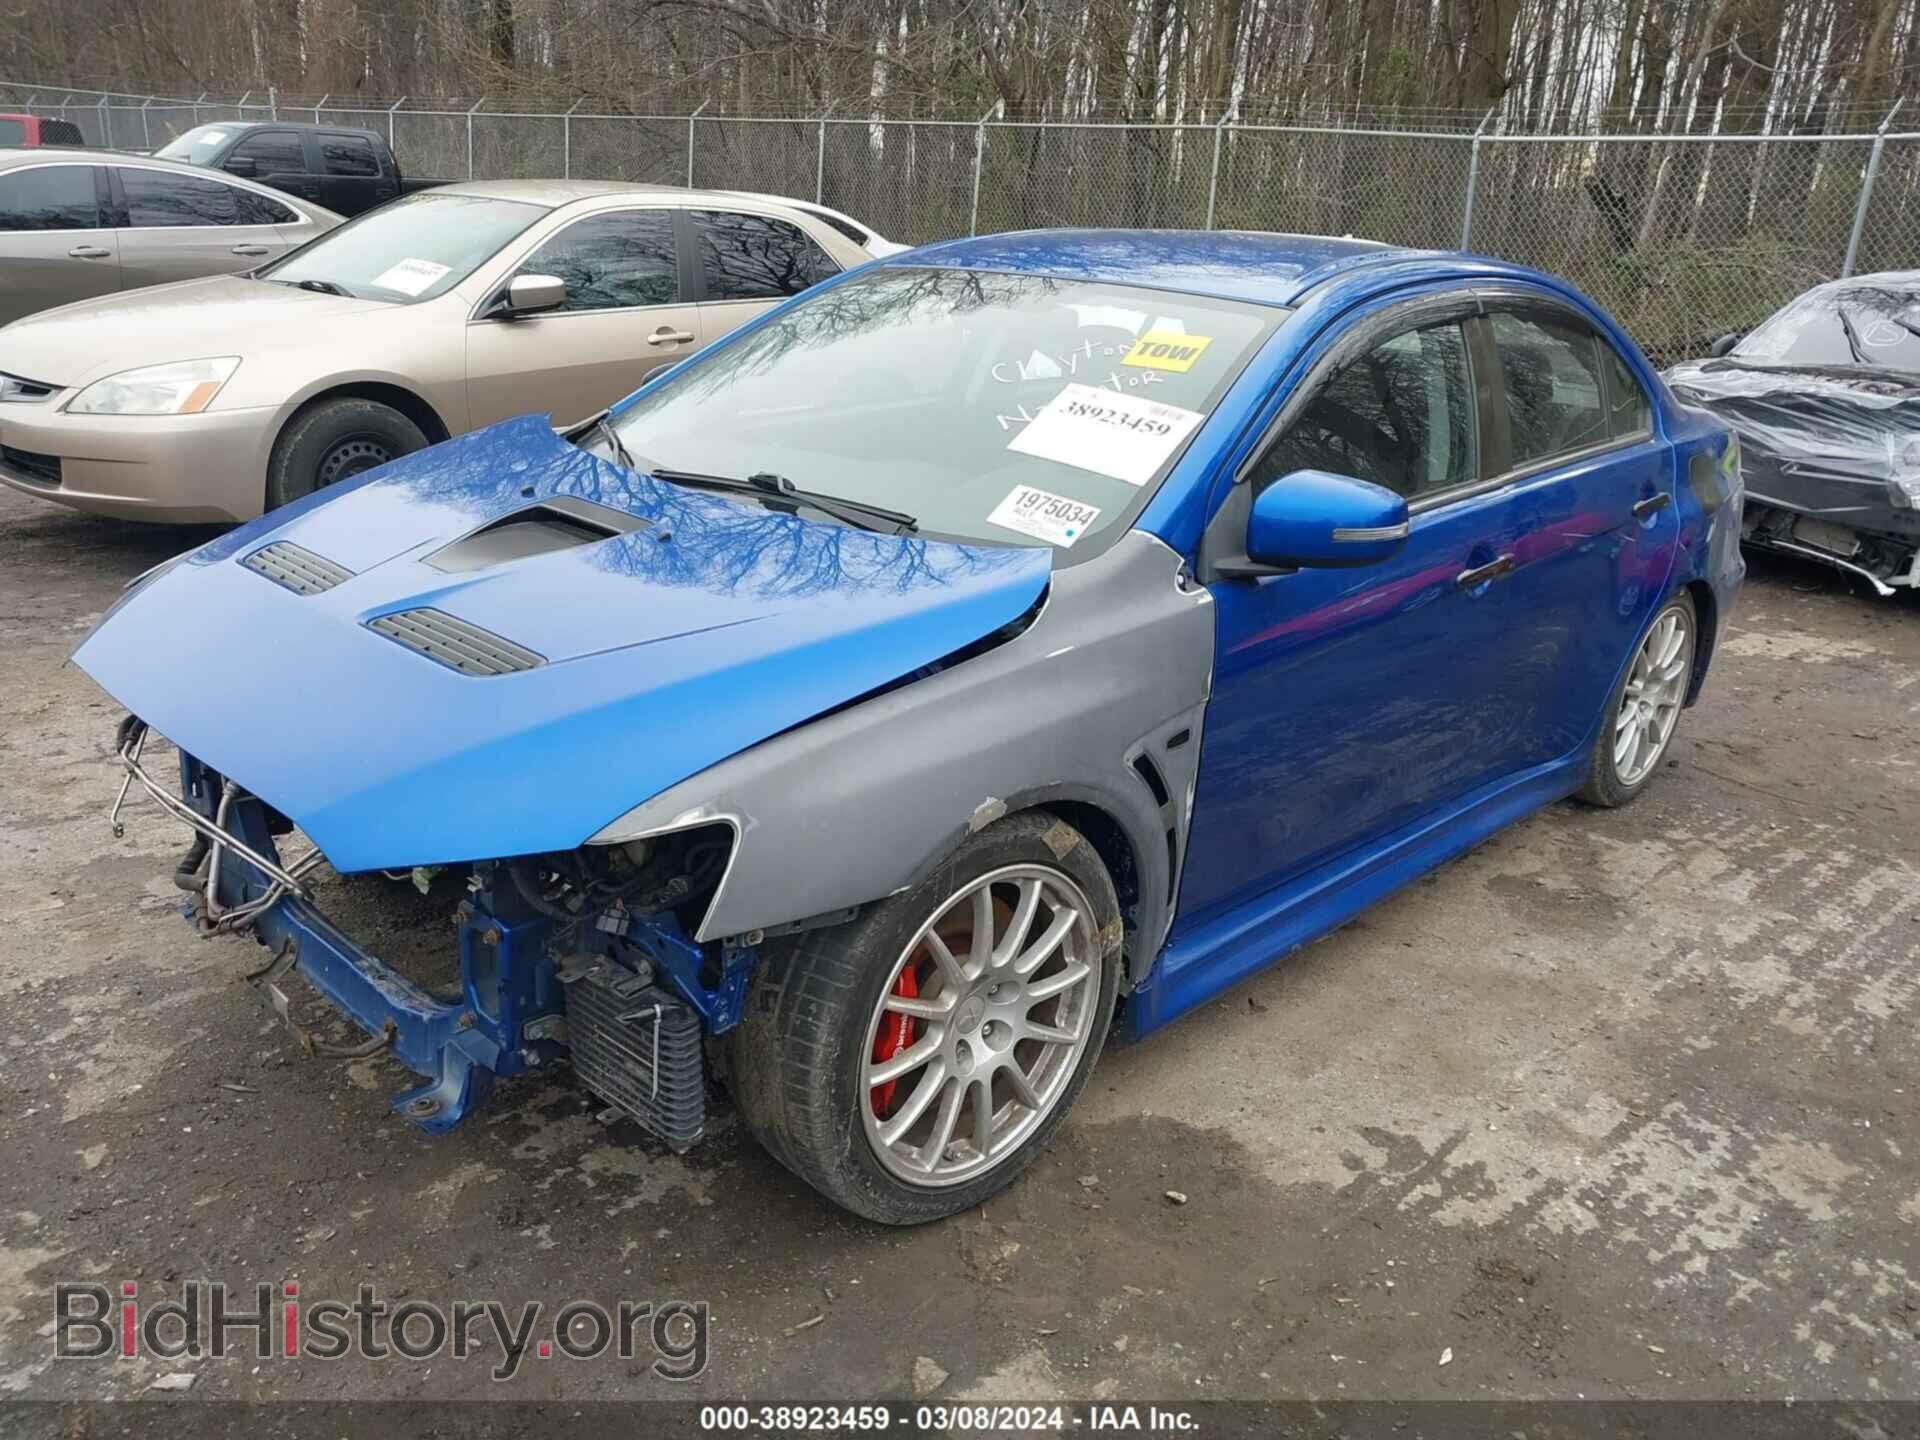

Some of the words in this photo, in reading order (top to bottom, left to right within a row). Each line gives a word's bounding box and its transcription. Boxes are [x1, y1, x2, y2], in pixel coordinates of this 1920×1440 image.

[1136, 341, 1199, 361] TOW
[1059, 400, 1172, 437] 38923459
[1016, 490, 1095, 526] 1975034
